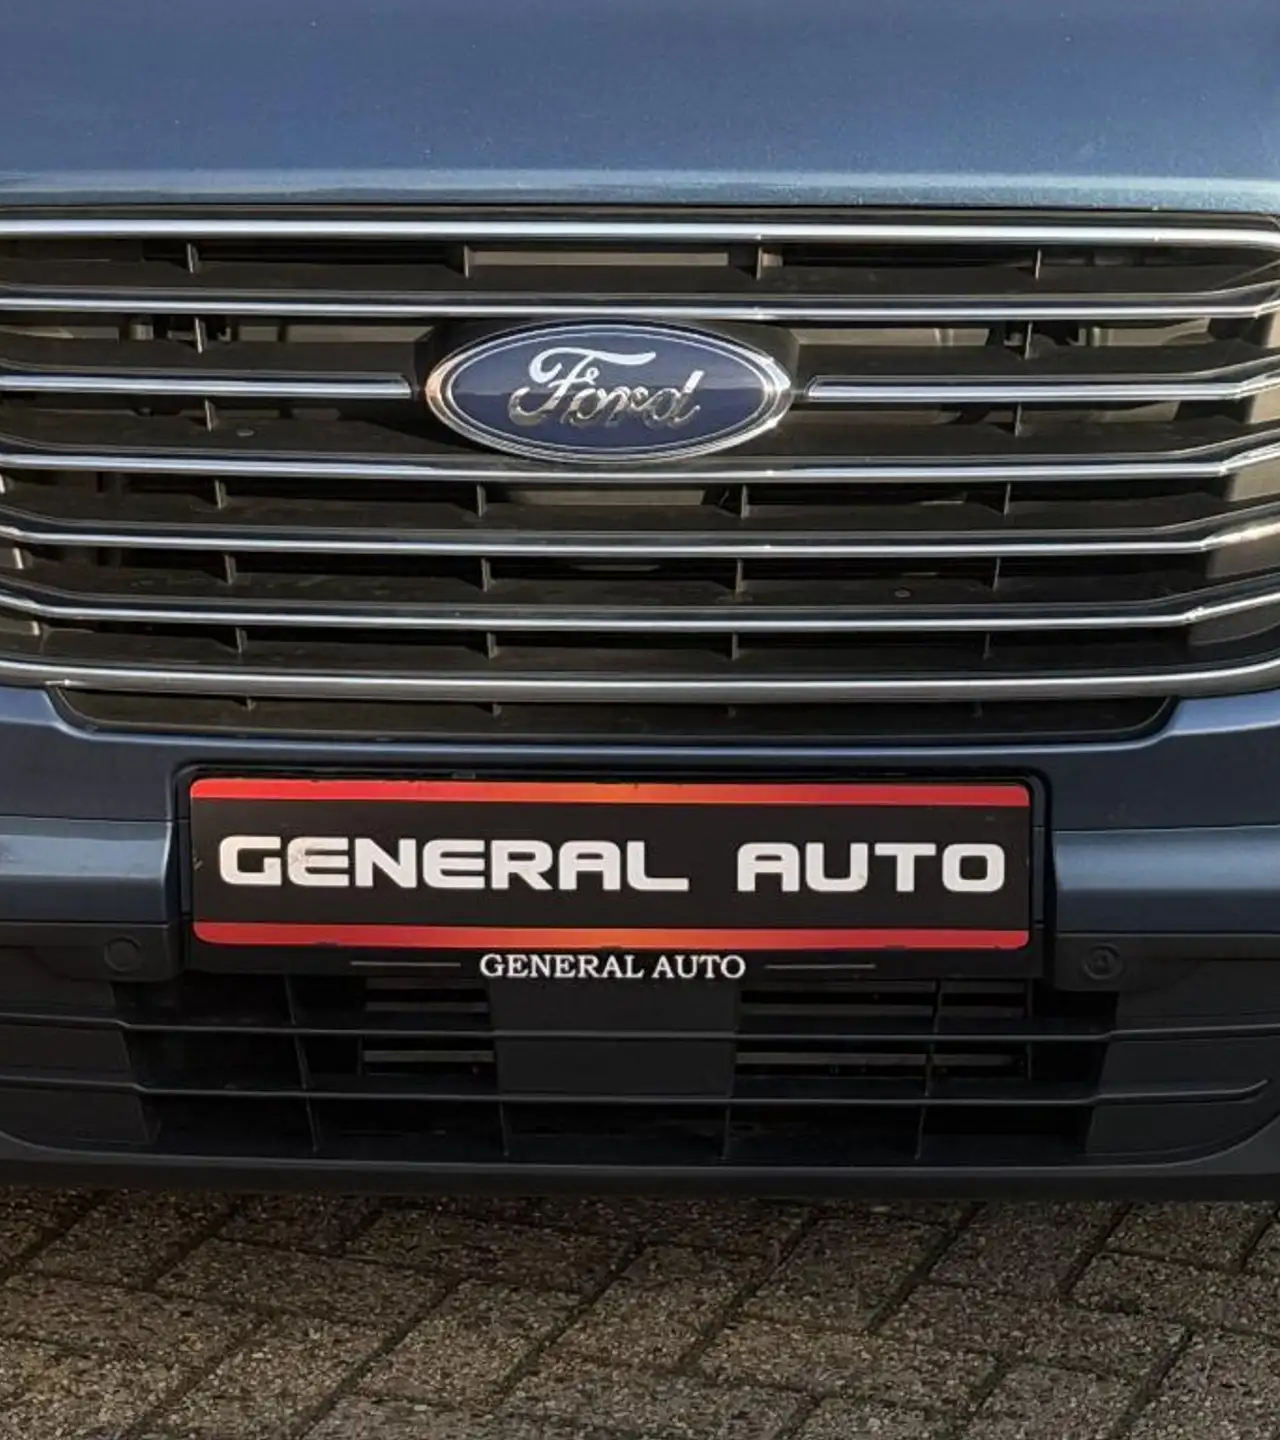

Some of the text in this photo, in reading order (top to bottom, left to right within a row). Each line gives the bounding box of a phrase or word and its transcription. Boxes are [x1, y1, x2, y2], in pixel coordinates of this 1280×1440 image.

[508, 346, 704, 427] Ford
[220, 835, 1005, 893] GENERAL AUTO
[479, 953, 746, 980] GENERAL AUTO
